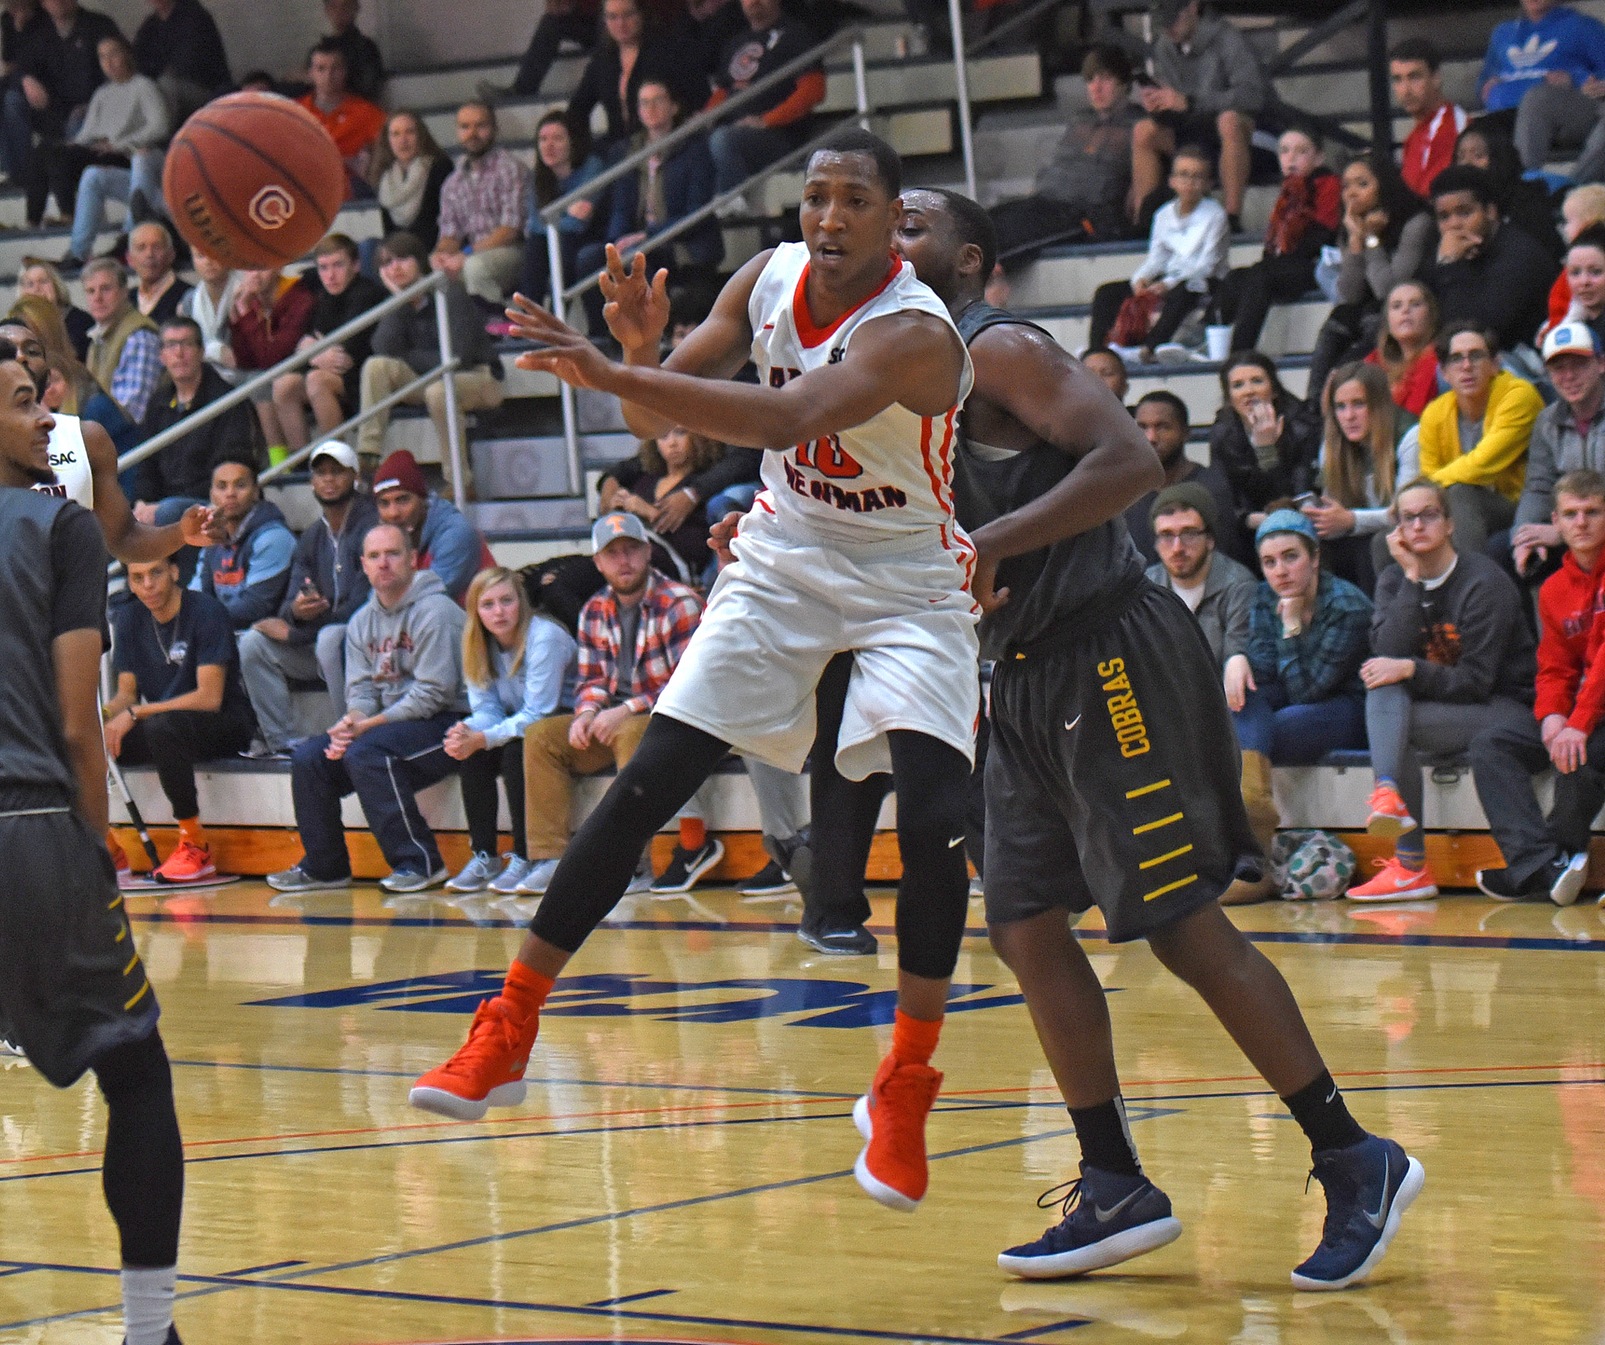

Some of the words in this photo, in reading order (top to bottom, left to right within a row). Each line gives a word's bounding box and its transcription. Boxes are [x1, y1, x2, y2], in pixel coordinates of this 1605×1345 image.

[49, 450, 77, 466] SAC
[605, 515, 625, 534] T
[1097, 657, 1151, 758] COBRAS
